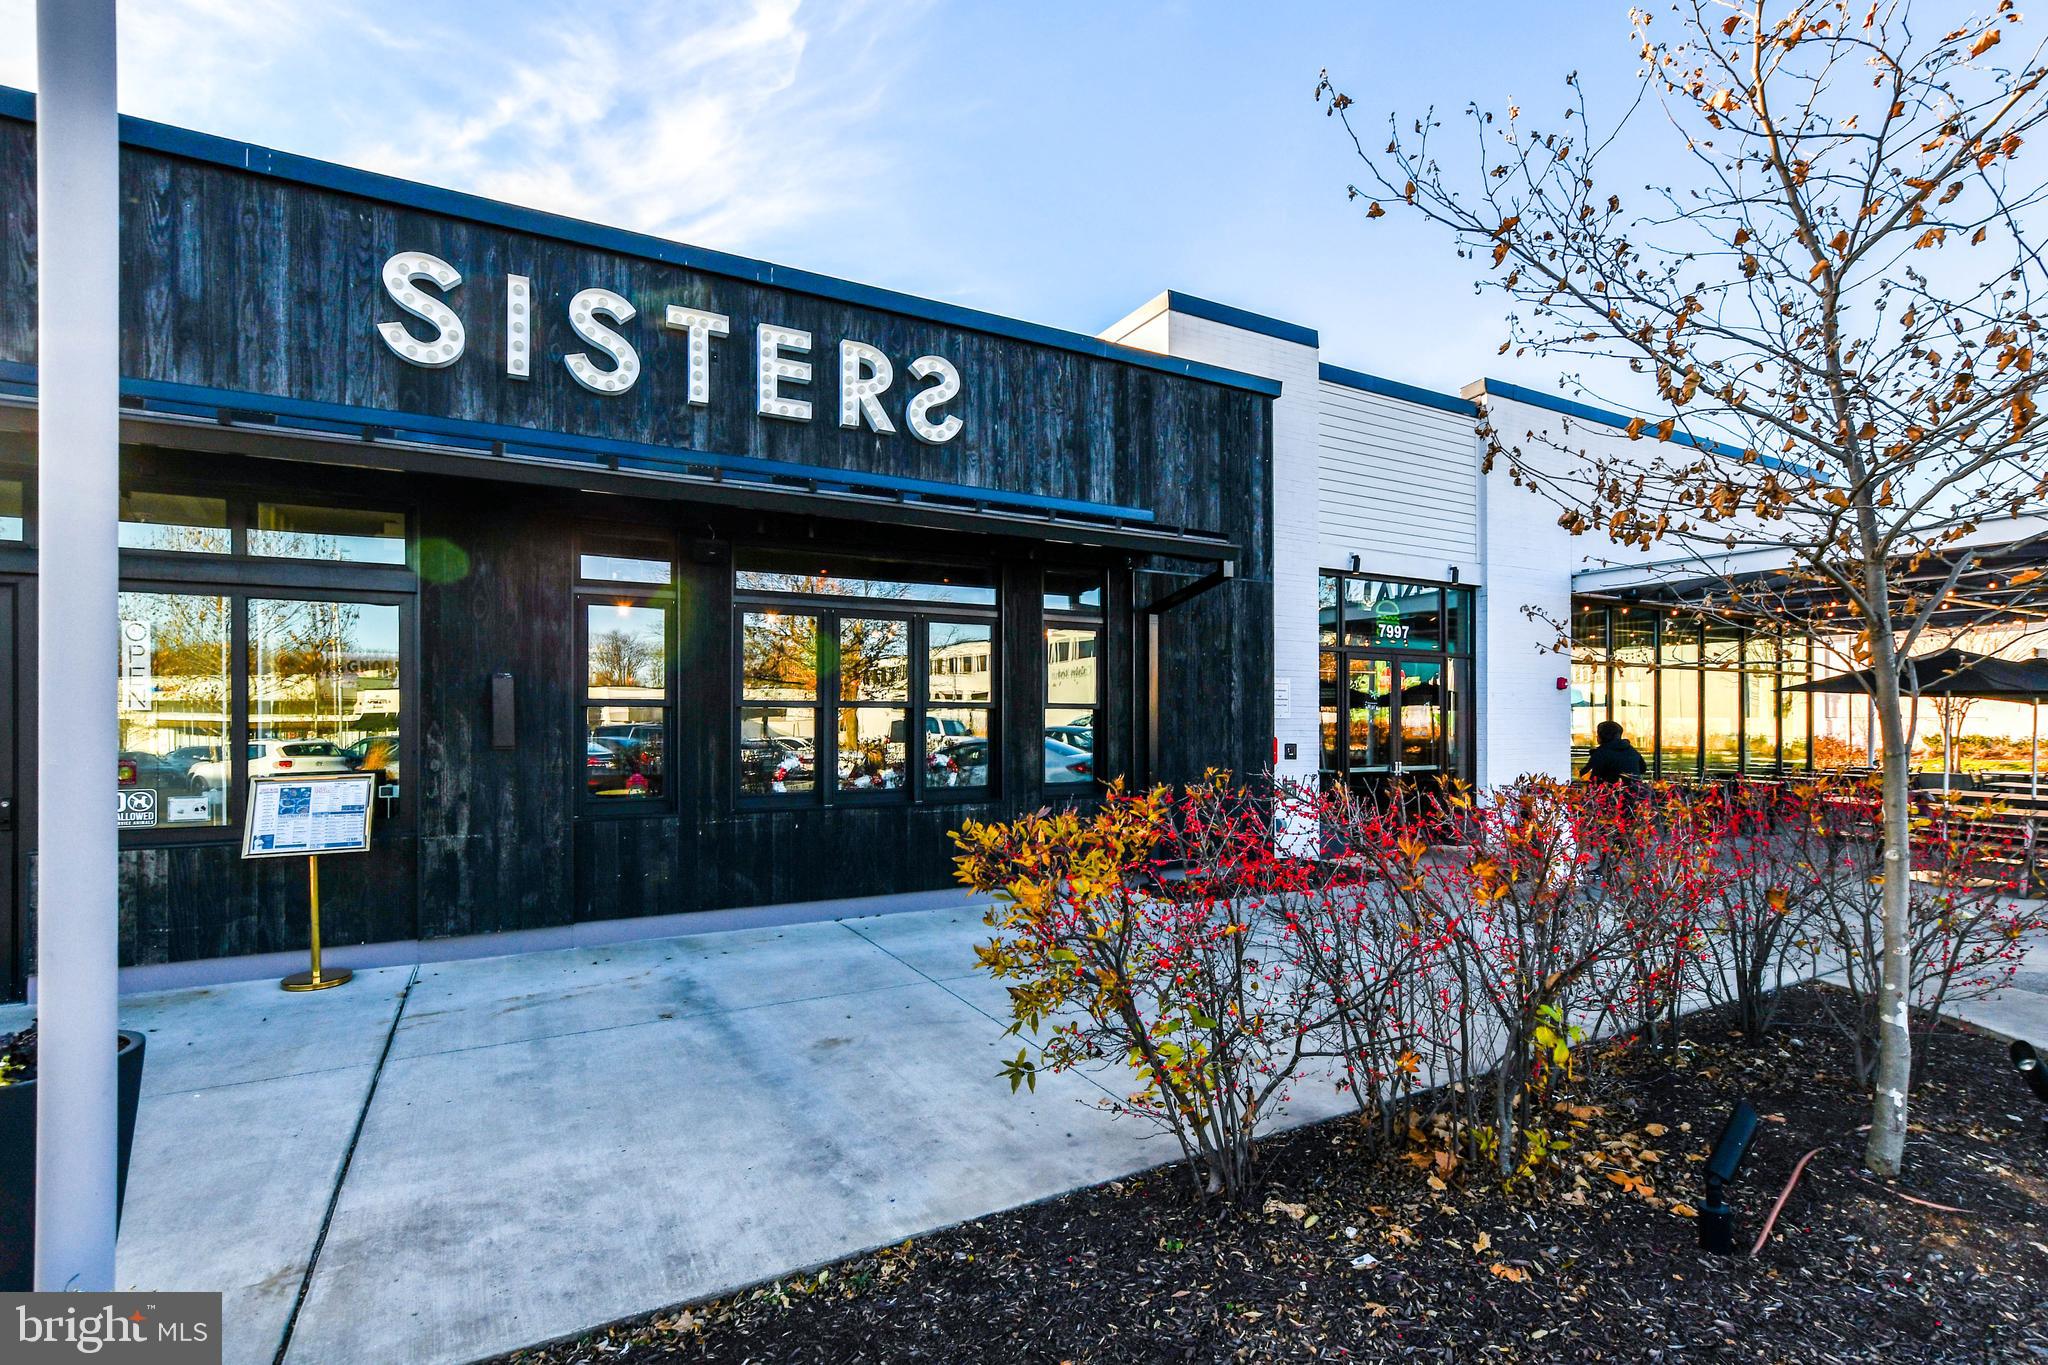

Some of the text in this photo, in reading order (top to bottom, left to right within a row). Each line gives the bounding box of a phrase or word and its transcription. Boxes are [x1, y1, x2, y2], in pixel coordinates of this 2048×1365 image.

[377, 251, 963, 445] SISTERS
[125, 623, 146, 707] OPEN
[1378, 624, 1409, 639] 7997
